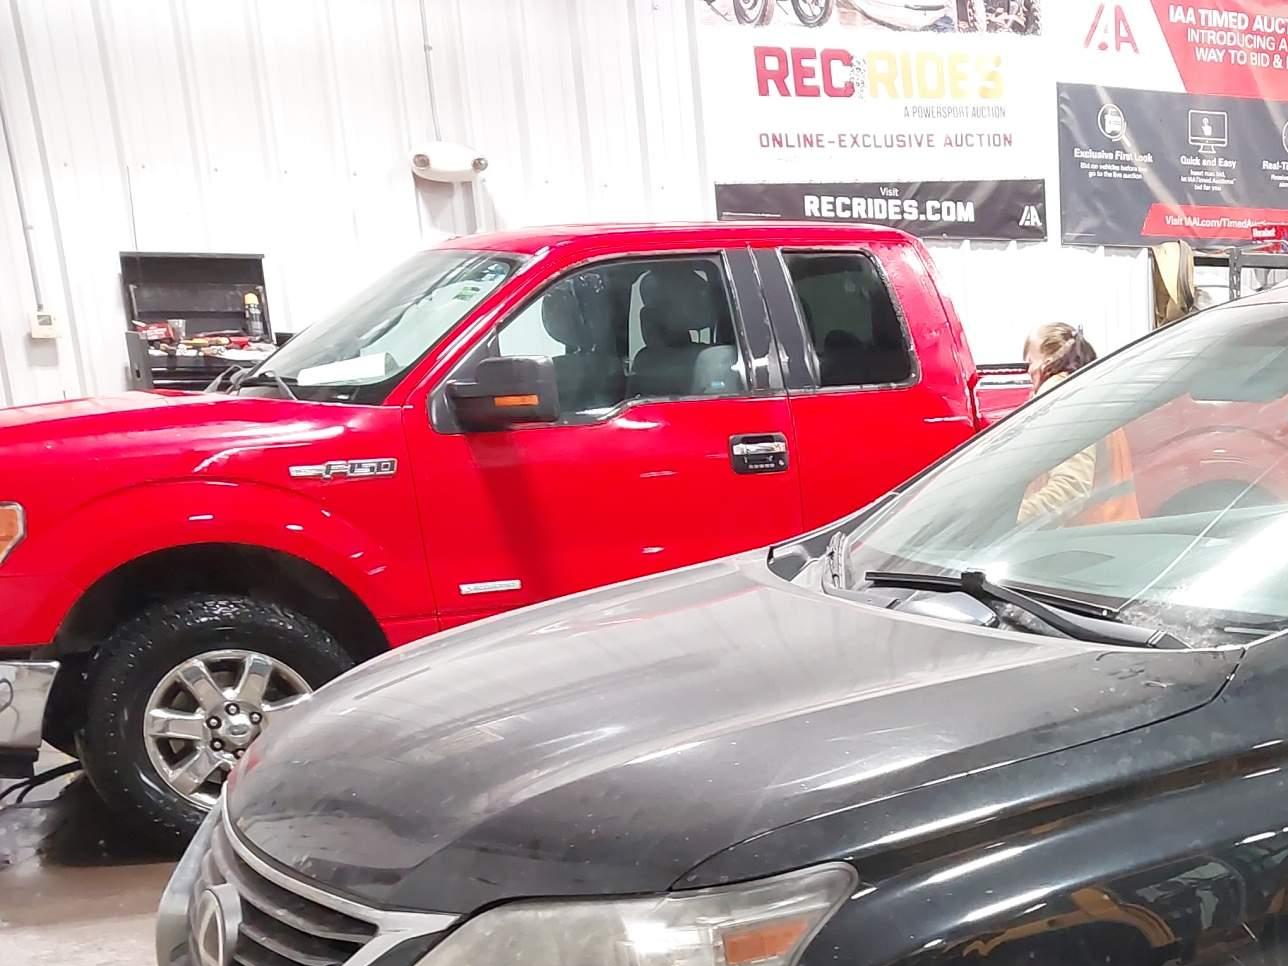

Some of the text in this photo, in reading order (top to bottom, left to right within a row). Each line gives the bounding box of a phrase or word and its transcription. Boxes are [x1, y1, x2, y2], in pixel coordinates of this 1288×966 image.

[1169, 5, 1197, 25] IAA
[1198, 9, 1249, 30] TIMED
[1187, 28, 1276, 51] INTRODUCING
[1278, 38, 1288, 52] A
[1194, 47, 1224, 63] WAY
[1228, 50, 1248, 65] TO
[1250, 52, 1270, 67] BID
[1272, 55, 1283, 69] &
[753, 46, 855, 98] REC
[904, 106, 1006, 119] A POWERSPORT AUCTION
[759, 132, 1013, 149] ONLINE-EXCLUSIVE AUCTION
[1074, 147, 1153, 163] Exclusive First Look
[1180, 155, 1236, 169] Quick and Easy
[880, 187, 899, 197] Visit
[804, 195, 975, 223] RECRIDES.COM
[1165, 215, 1184, 226] Visit
